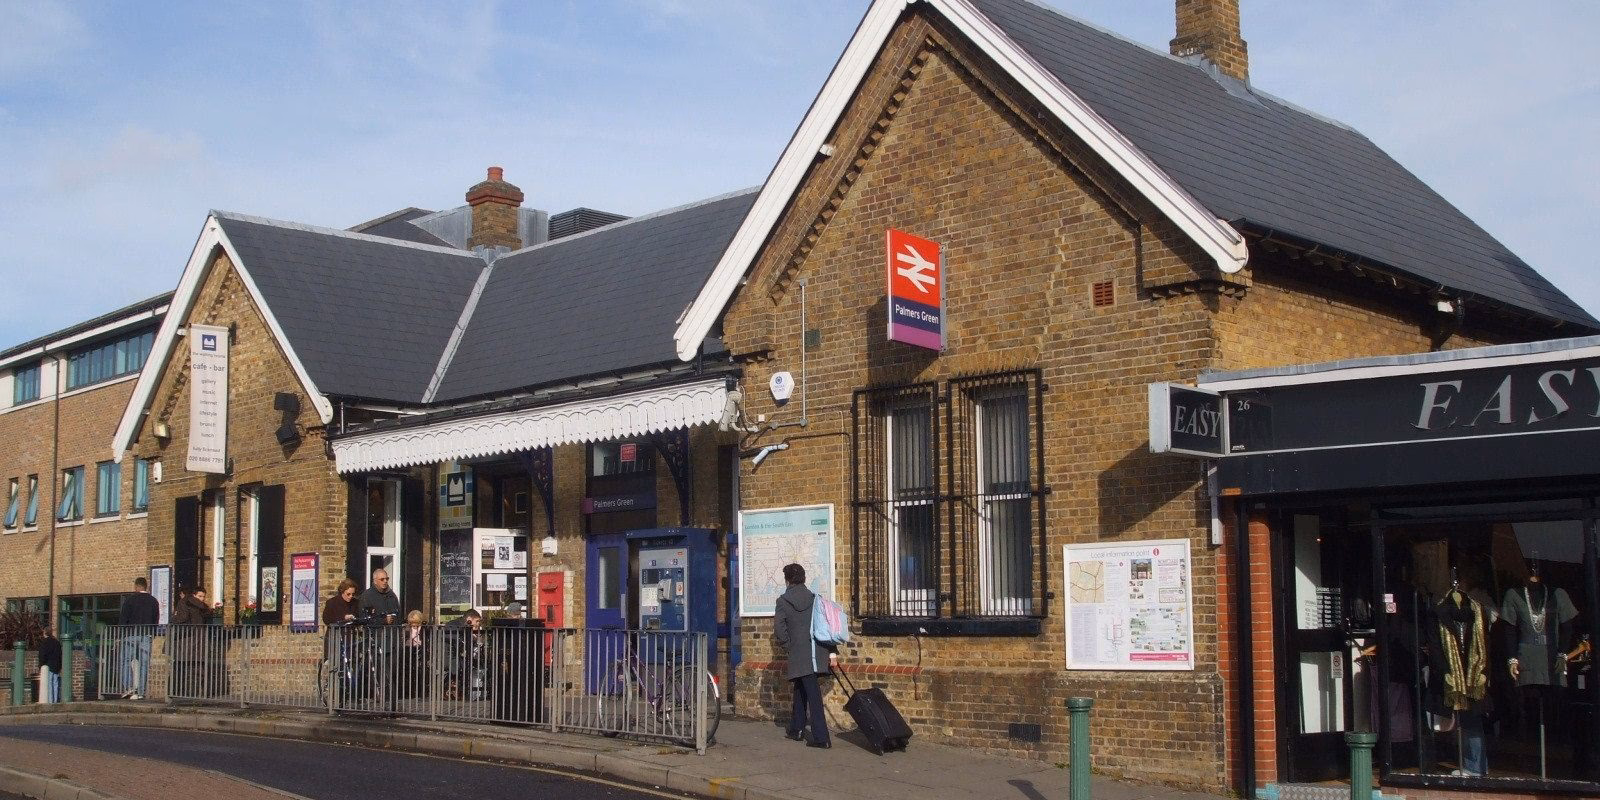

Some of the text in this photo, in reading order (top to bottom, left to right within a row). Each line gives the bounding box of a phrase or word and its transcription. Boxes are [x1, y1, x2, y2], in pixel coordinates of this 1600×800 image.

[895, 304, 939, 324] Palmers Green
[1237, 400, 1250, 411] 26
[1409, 368, 1600, 430] EAS
[1173, 405, 1222, 438] EASY
[594, 500, 616, 508] Palmers
